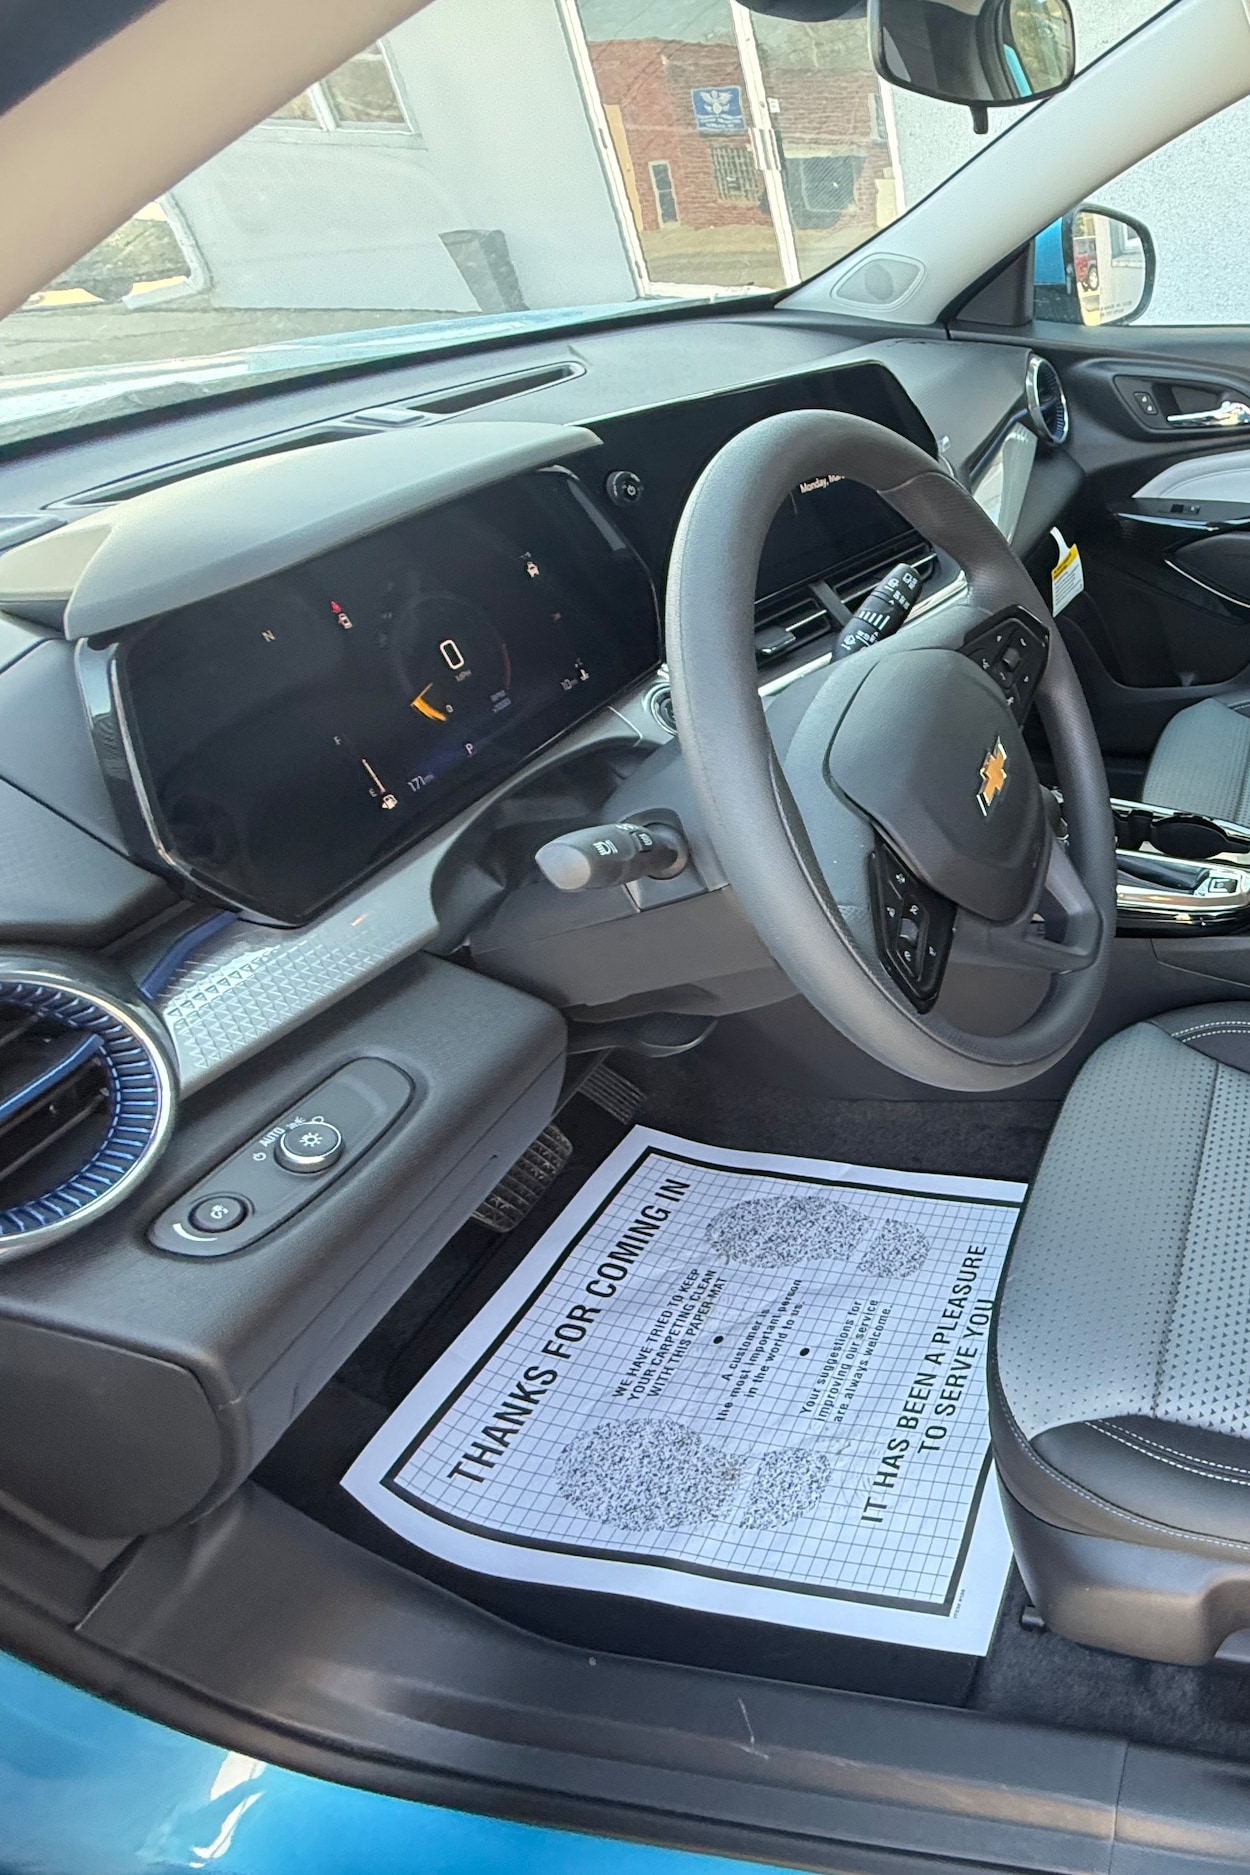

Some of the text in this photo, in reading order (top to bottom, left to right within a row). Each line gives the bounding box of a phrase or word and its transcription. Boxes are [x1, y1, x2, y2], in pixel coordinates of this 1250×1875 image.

[799, 476, 829, 494] Monday,
[440, 639, 464, 670] 0
[464, 742, 474, 757] P
[259, 1126, 286, 1148] AUTO
[447, 1178, 691, 1483] THANKS FOR COMING IN
[612, 1268, 701, 1397] WE HAVE TRIED TO KEEP
[627, 1270, 717, 1401] YOUR CARPETING CLEAN
[647, 1277, 726, 1397] WITH THIS PAPER MAT
[716, 1279, 802, 1421] the most important person
[721, 1308, 770, 1381] A customer is
[744, 1301, 806, 1398] in the world to us.
[800, 1301, 862, 1414] Your suggestions for
[814, 1300, 878, 1421] improving our service
[834, 1305, 893, 1422] are always welcome.
[861, 1244, 988, 1523] IT HAS BEEN A PLEASURE
[918, 1298, 994, 1454] TO SERVE YOU
